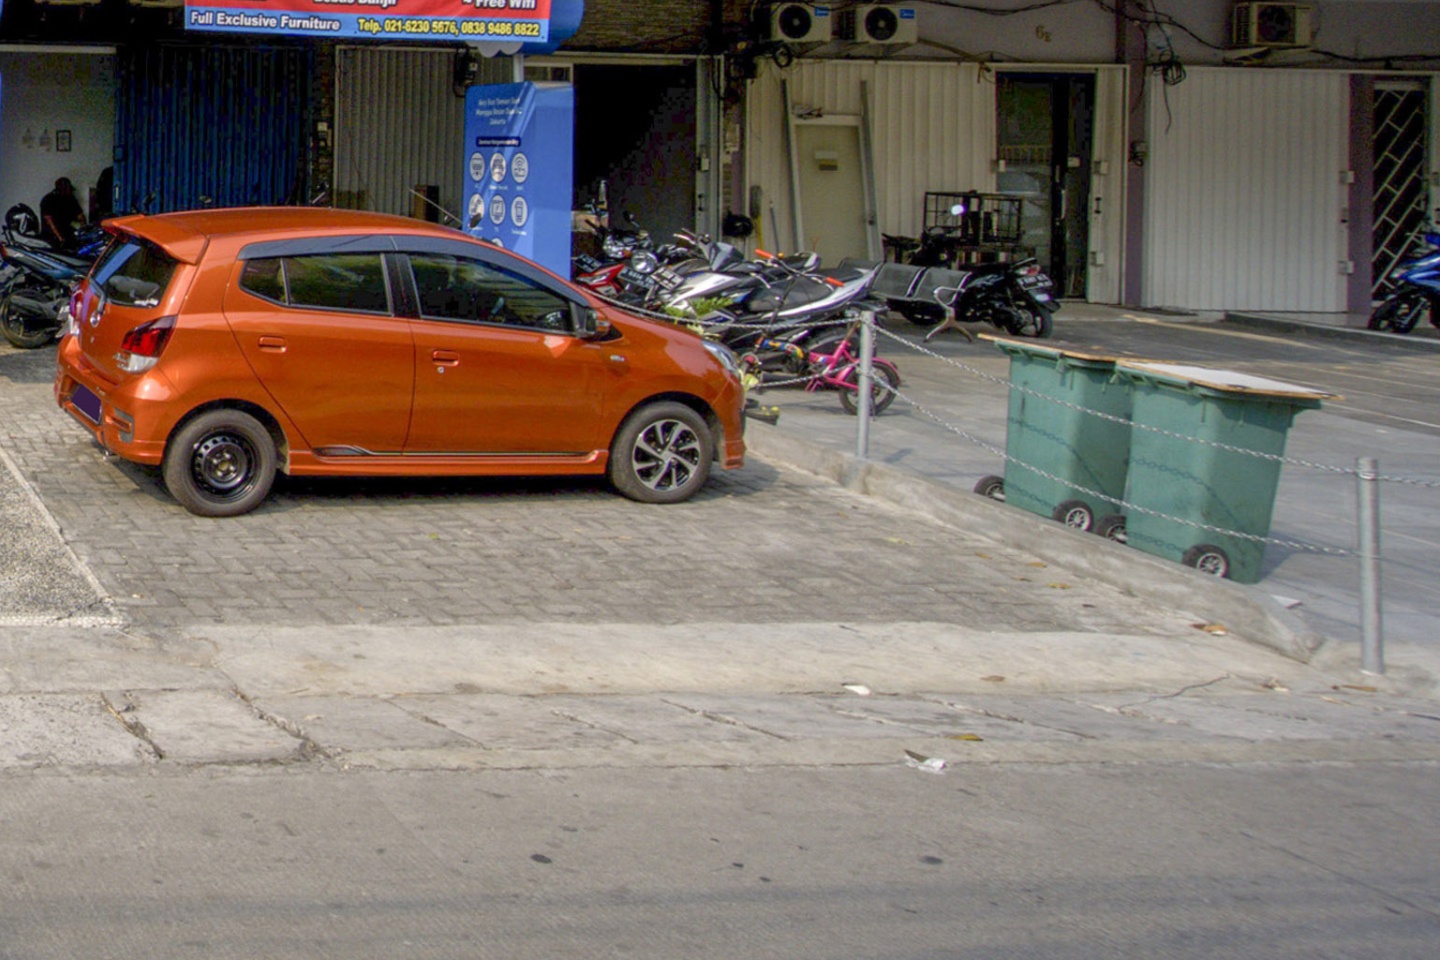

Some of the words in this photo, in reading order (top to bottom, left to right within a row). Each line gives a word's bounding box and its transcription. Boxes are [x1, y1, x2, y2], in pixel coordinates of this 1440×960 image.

[190, 11, 213, 24] Full
[216, 13, 277, 28] Exclusive
[280, 15, 341, 31] Furniture
[358, 18, 382, 34] Telp.
[384, 19, 430, 33] 021-6230
[461, 21, 486, 35] 0838
[488, 22, 512, 35] 9486
[514, 23, 540, 36] 8822
